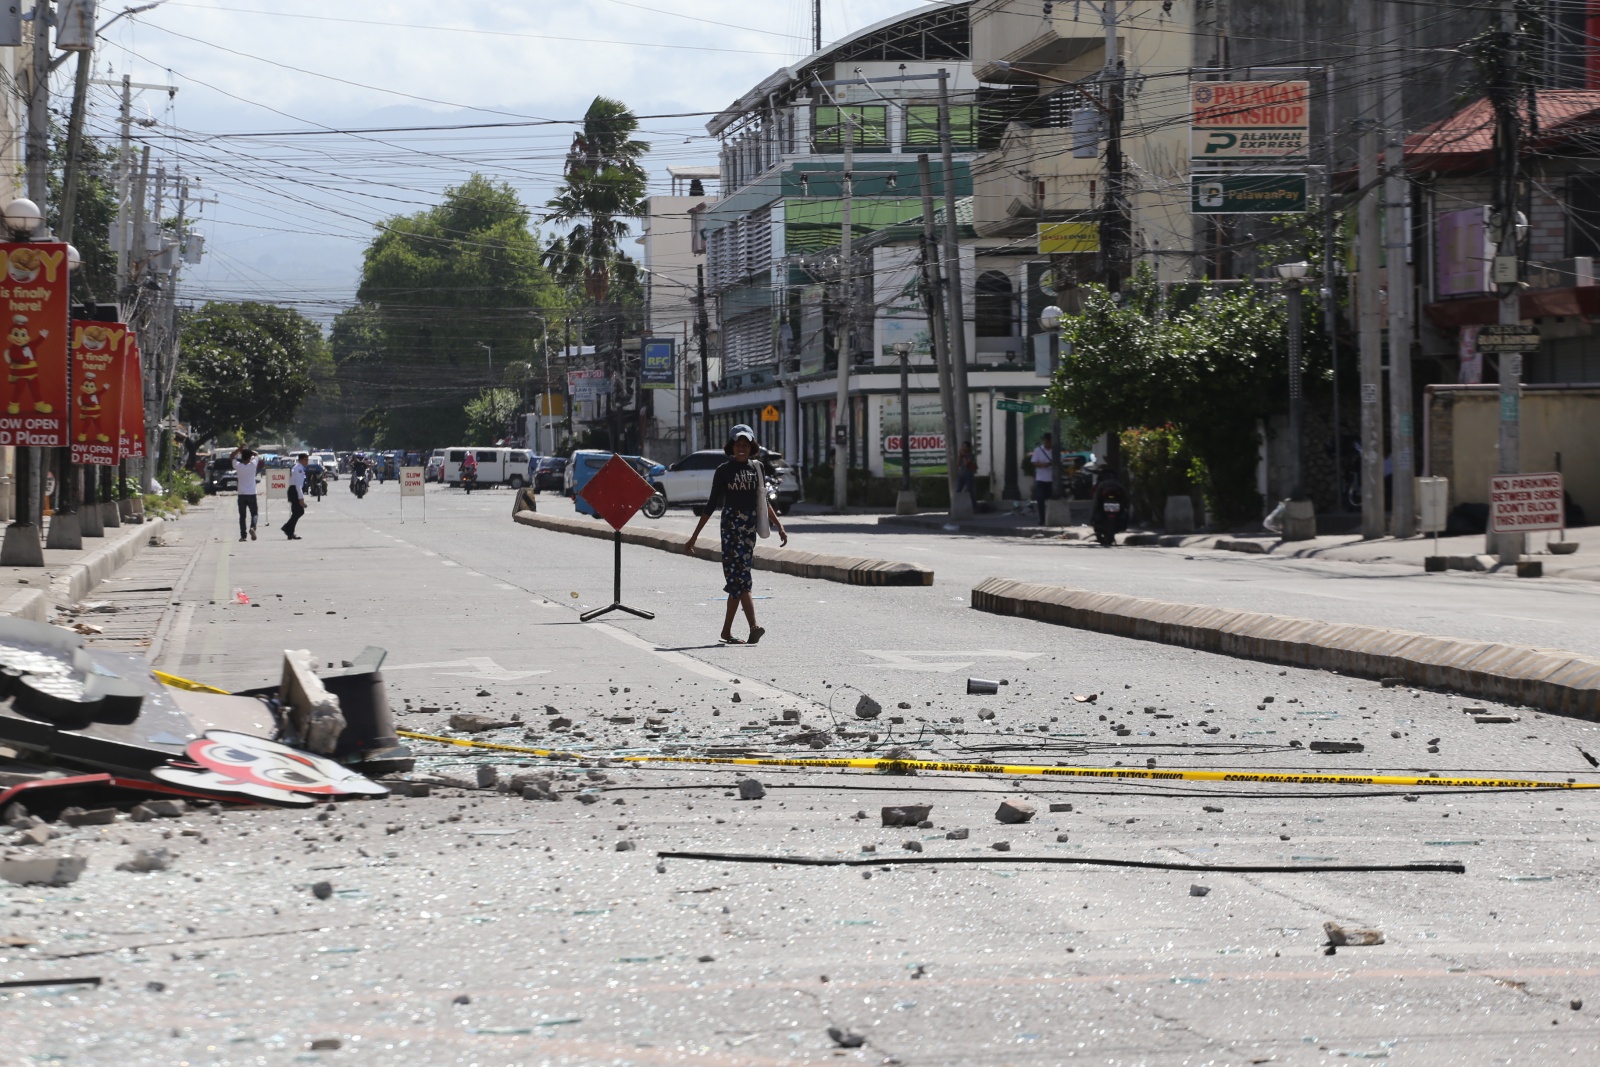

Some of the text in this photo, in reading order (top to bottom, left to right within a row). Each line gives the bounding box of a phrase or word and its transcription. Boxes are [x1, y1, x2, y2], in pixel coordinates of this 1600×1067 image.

[1214, 85, 1306, 105] PALAWAN
[1194, 106, 1304, 125] PAWNSHOP
[1239, 141, 1302, 149] EXPRESS
[1227, 189, 1300, 201] PalawanPay
[0, 286, 52, 301] is finally
[9, 299, 42, 311] here!
[71, 325, 124, 352] JOY
[76, 352, 114, 364] is finally
[647, 356, 669, 367] RFC
[0, 418, 59, 430] OW OPEN
[16, 431, 58, 445] Plaza
[71, 444, 87, 453] OW
[89, 444, 113, 454] OPEN
[82, 453, 112, 465] Plaza
[1494, 477, 1560, 490] NO PARKING
[1492, 489, 1561, 502] BETWEEN SIGNS
[1527, 501, 1557, 513] BLOCK
[1495, 515, 1515, 526] THIS
